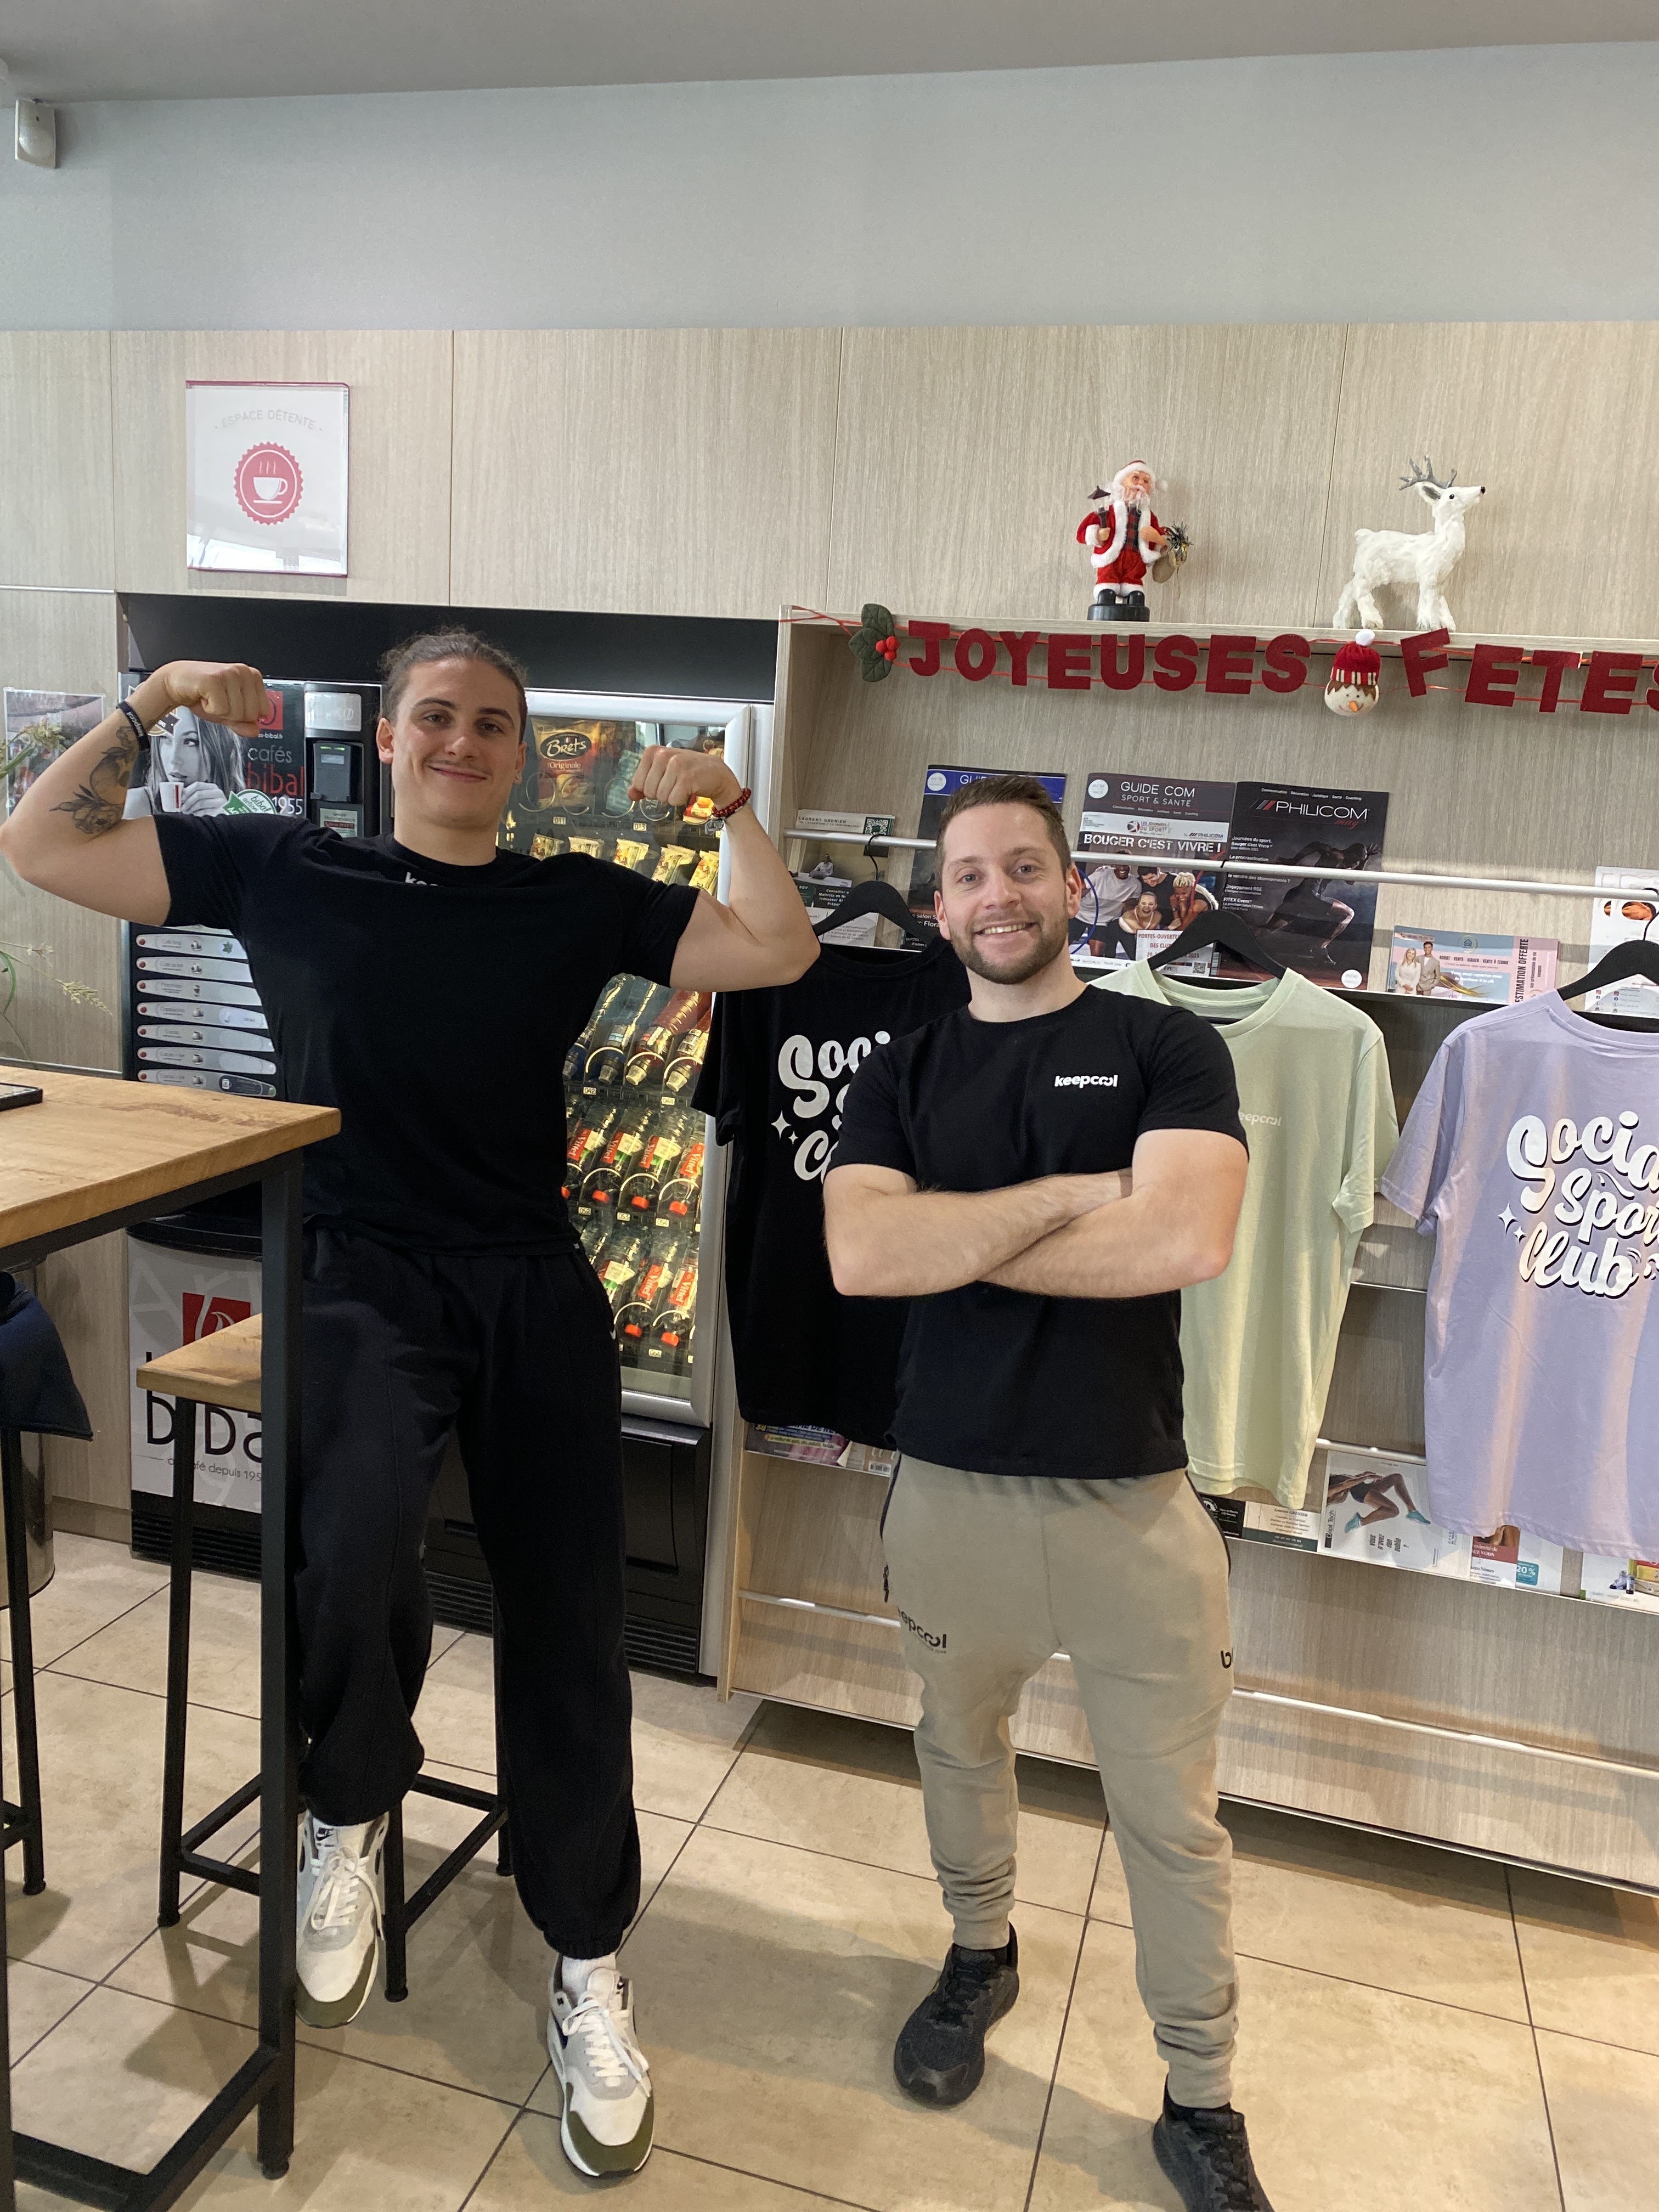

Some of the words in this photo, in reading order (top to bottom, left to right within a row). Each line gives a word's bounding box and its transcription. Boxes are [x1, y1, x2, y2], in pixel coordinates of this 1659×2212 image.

[221, 410, 263, 428] ESPACE
[268, 409, 316, 430] DÉTENTE
[909, 620, 1311, 694] JOYEUSES
[247, 744, 292, 763] cafés
[549, 761, 581, 770] Originale
[247, 760, 304, 797] bibal
[1120, 781, 1160, 794] GUIDE
[1164, 786, 1195, 798] COM
[272, 796, 303, 815] 1955
[1121, 794, 1150, 803] SPORT
[1162, 798, 1192, 807] SANTÉ
[1276, 800, 1368, 820] PHILICOM
[1084, 833, 1135, 848] BOUGER
[1138, 838, 1173, 850] C'EST
[1178, 841, 1214, 853] VIVRE
[1217, 843, 1221, 853] !
[1518, 939, 1529, 964] OFFERTE
[1054, 1074, 1118, 1088] keepcool
[1239, 1111, 1282, 1126] eepcool
[568, 1137, 586, 1156] Vittel
[603, 1139, 619, 1159] Vittel
[640, 1144, 655, 1164] Vittel
[685, 1153, 702, 1173] Vittel
[1506, 1110, 1659, 1214] Socia
[1554, 1167, 1659, 1245] Spor
[642, 1275, 661, 1297] Vittel
[675, 1282, 691, 1303] Vittel
[209, 1464, 241, 1477] depuis
[243, 1470, 262, 1482] 195
[896, 1606, 947, 1649] epcool
